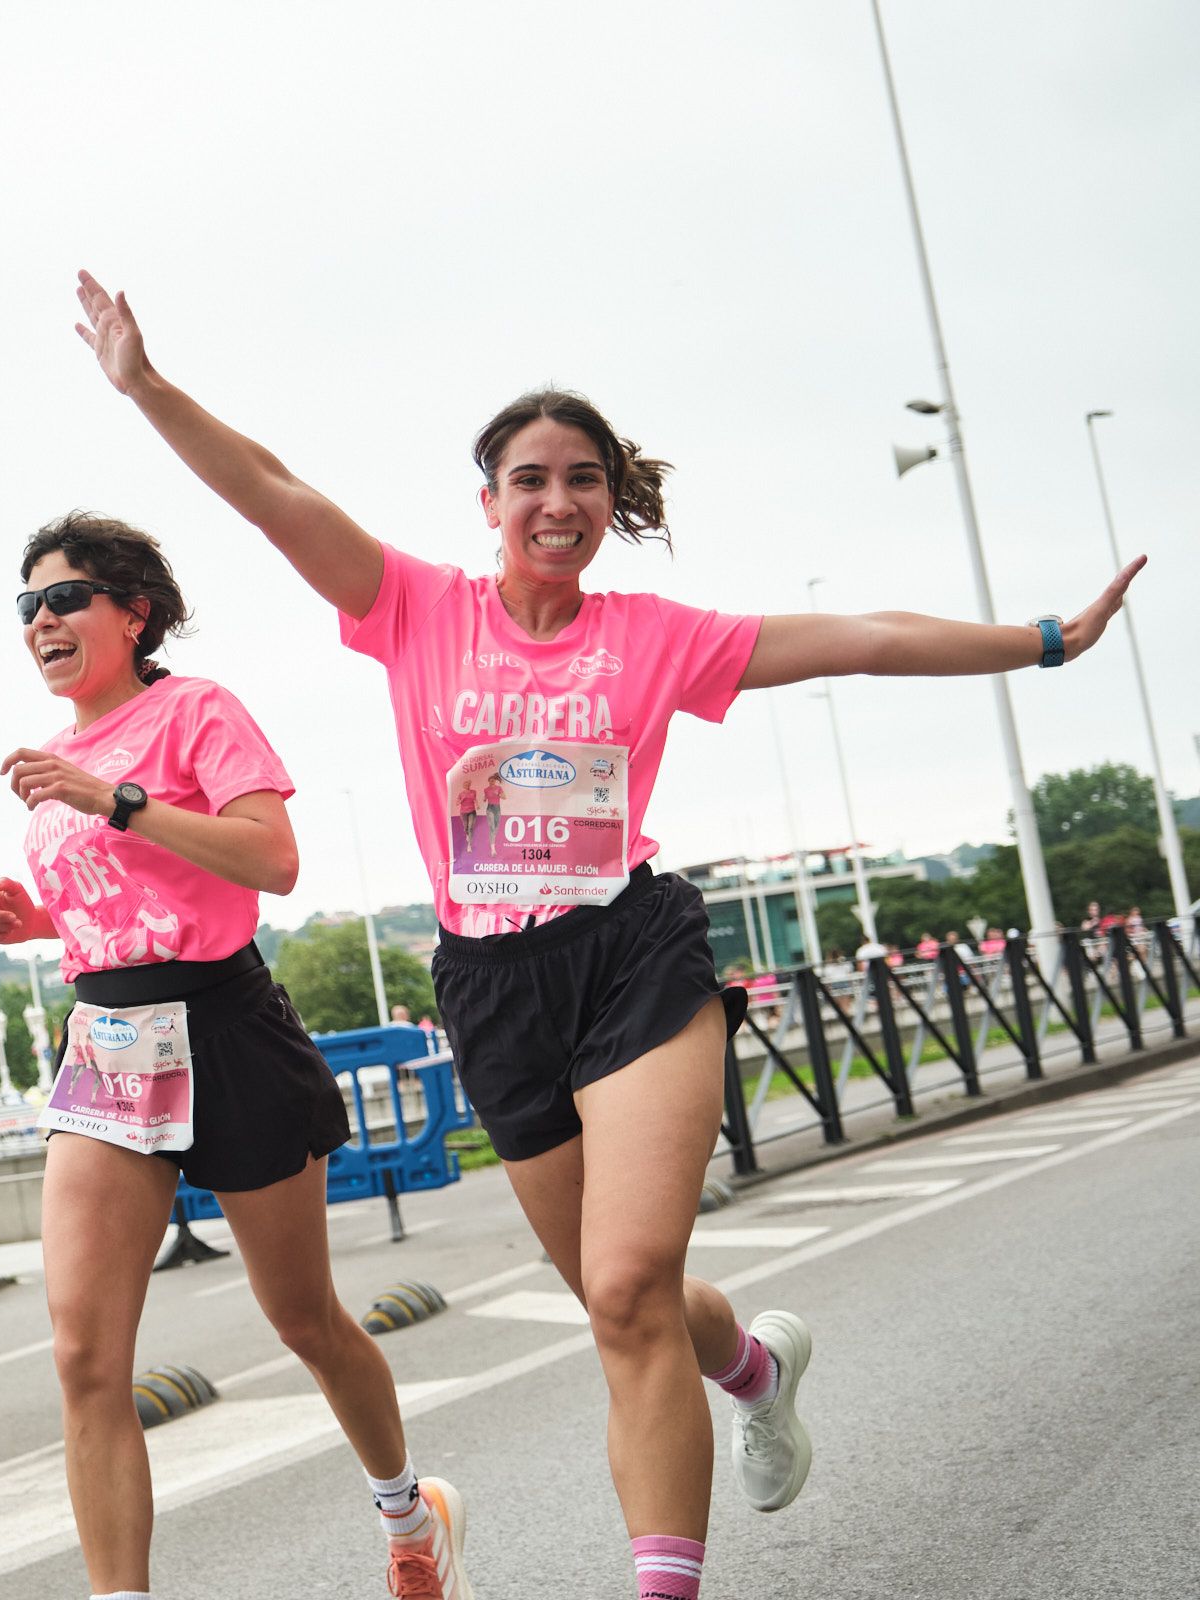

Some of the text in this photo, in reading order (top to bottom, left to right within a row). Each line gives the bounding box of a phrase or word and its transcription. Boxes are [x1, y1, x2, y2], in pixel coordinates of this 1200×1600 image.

[451, 689, 614, 740] CARRERA
[462, 759, 496, 774] SUMA
[506, 764, 570, 780] ASTURIANA
[504, 816, 570, 843] 016
[522, 848, 552, 860] 1304
[474, 863, 599, 875] CARRERA DE LA MUJER GIJÓN
[466, 882, 519, 895] OYSHO
[553, 885, 608, 896] Santander
[102, 1073, 143, 1098] 016
[70, 1105, 105, 1117] CARRERA
[106, 1111, 118, 1120] DE
[118, 1114, 129, 1123] LA
[116, 1101, 136, 1112] 1305
[58, 1115, 108, 1132] OYSHO
